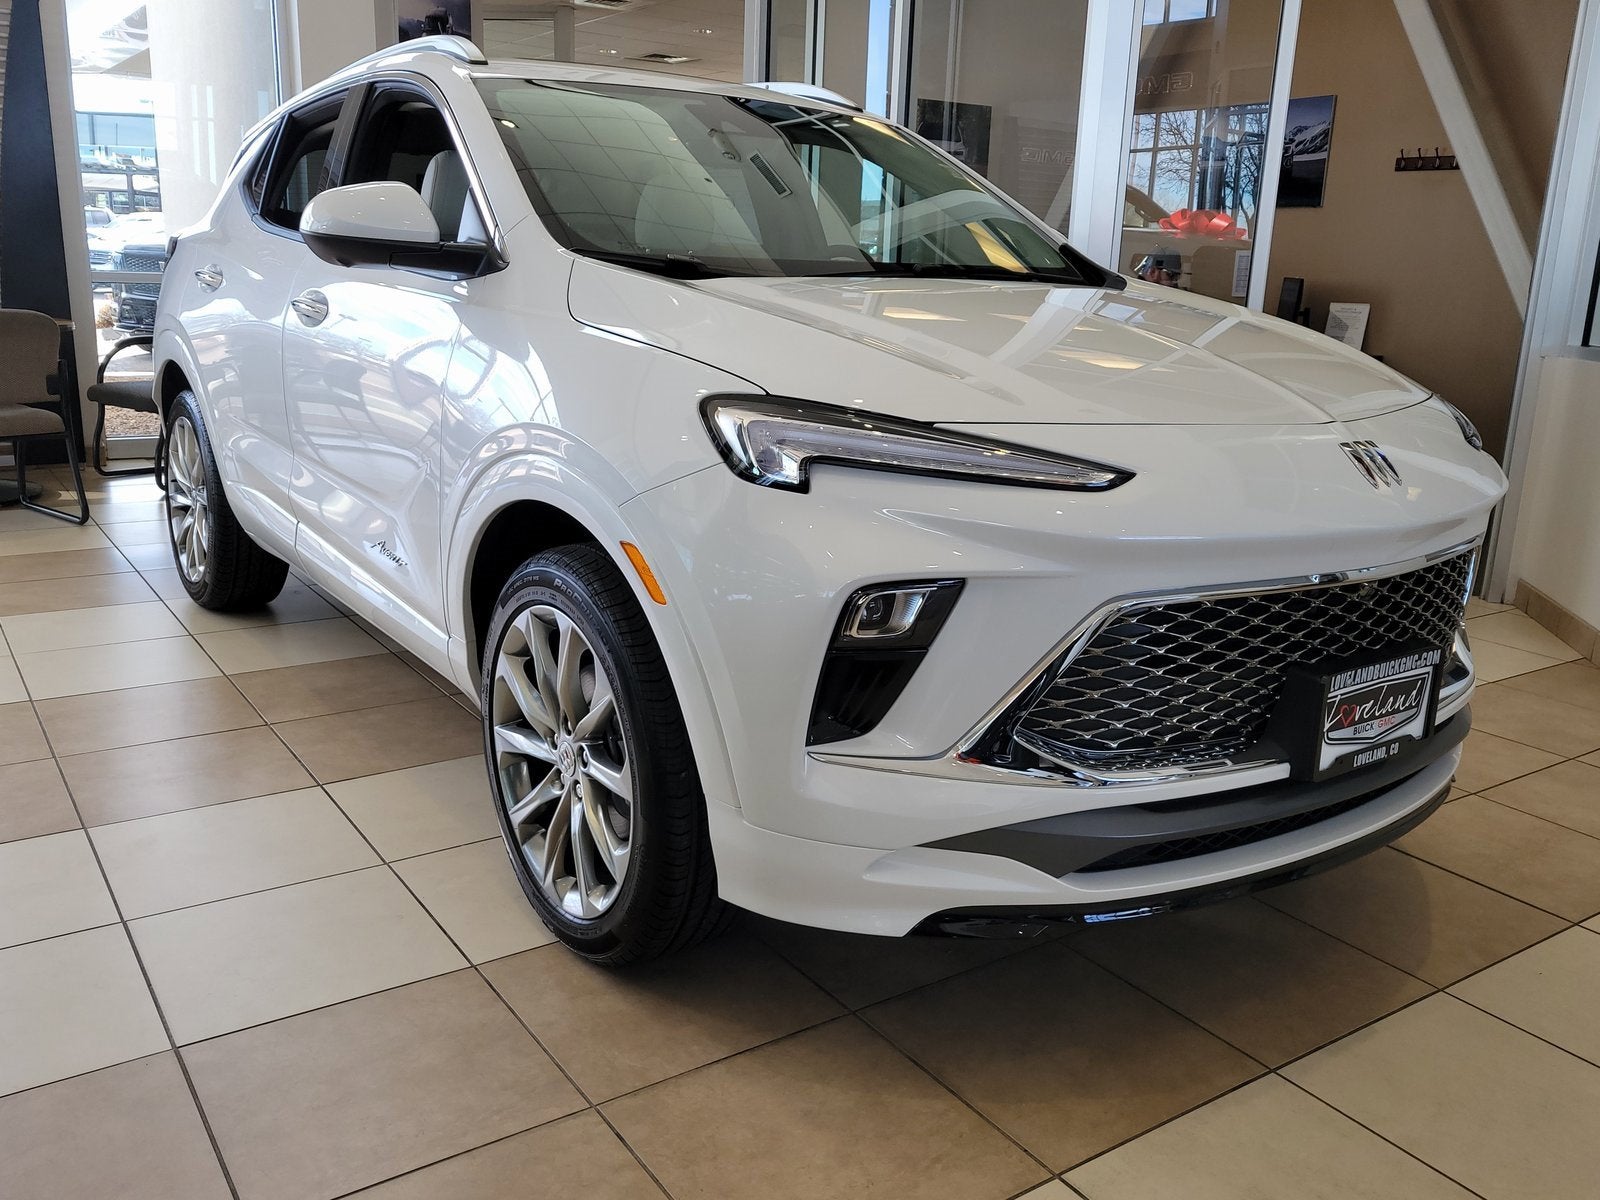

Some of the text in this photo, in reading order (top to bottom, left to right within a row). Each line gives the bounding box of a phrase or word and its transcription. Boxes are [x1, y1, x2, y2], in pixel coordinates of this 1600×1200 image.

[1330, 649, 1441, 692] LOVELANDBUICKGMC.COM
[1353, 716, 1396, 736] BUICK GMC
[1390, 742, 1399, 755] CO
